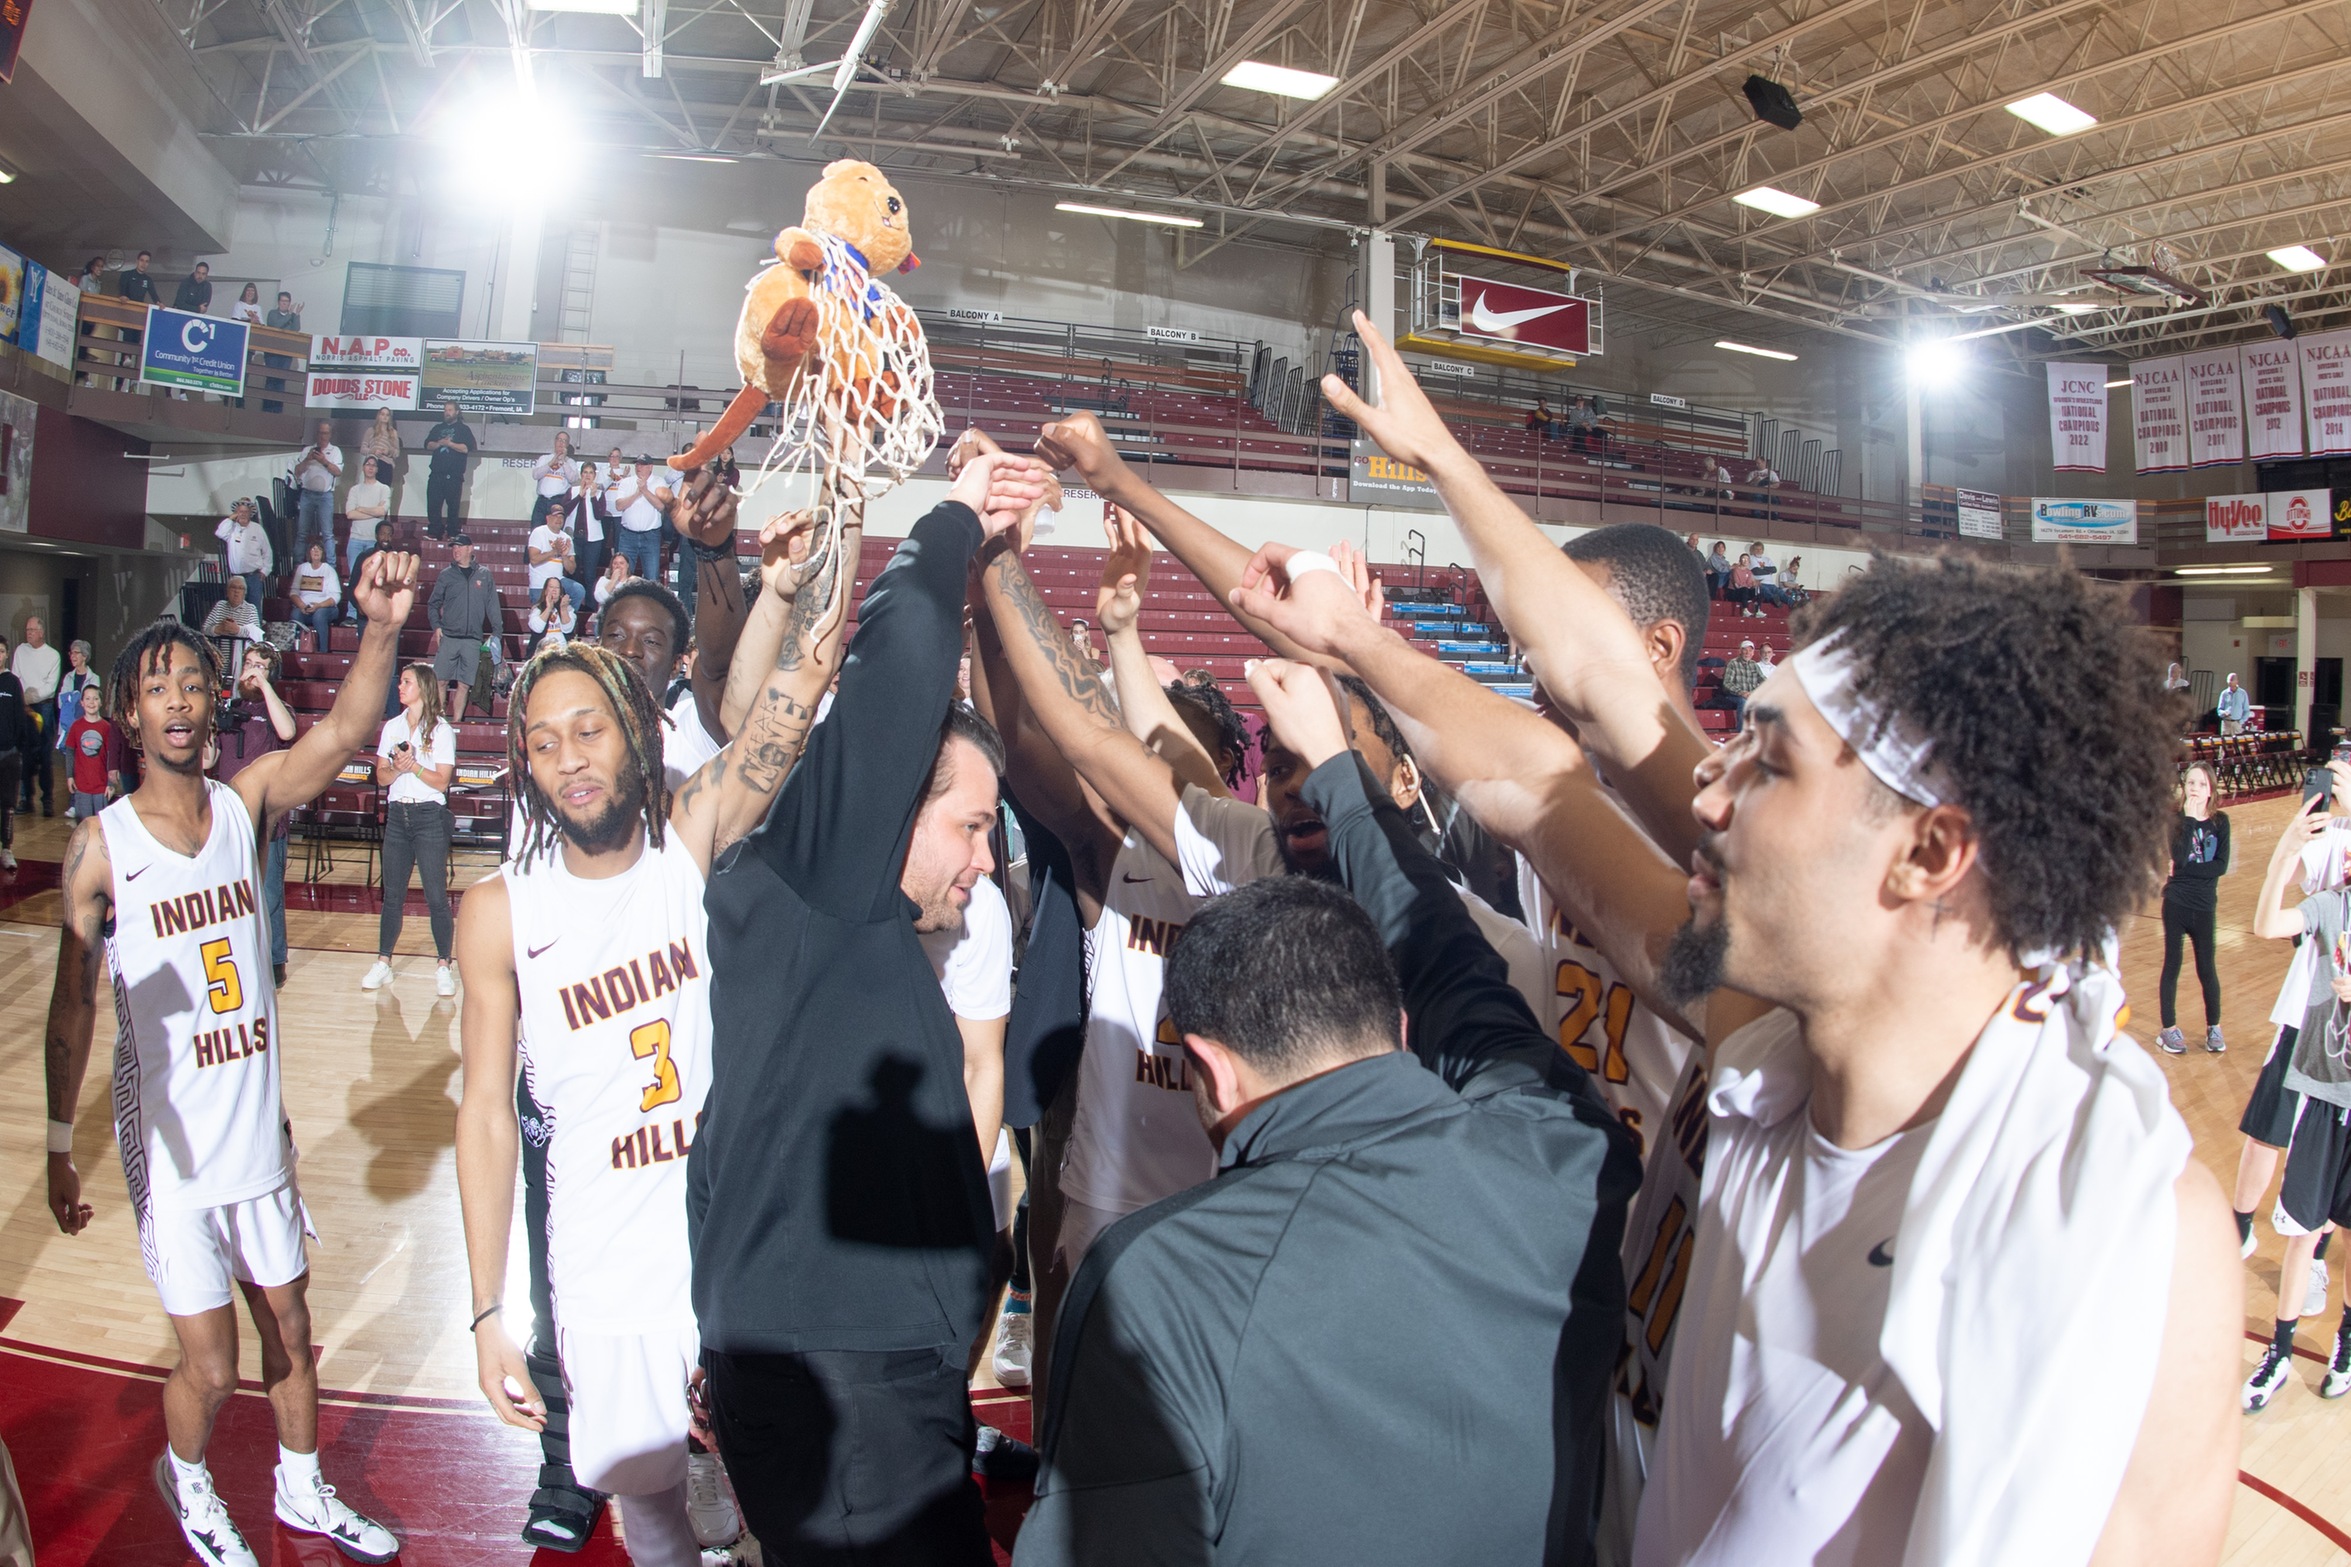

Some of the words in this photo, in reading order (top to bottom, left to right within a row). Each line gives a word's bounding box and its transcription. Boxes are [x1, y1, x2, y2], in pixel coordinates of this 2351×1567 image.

[950, 309, 989, 321] BALCONY
[993, 313, 1000, 321] A
[1150, 328, 1187, 340] BALCONY
[1190, 333, 1197, 341] B
[155, 350, 191, 365] Community
[199, 357, 218, 368] Credit
[218, 361, 235, 371] Union
[348, 355, 382, 363] ASPHALT
[386, 356, 415, 364] PAVING
[392, 348, 411, 357] co.
[2248, 350, 2290, 368] NJCAA
[2306, 344, 2351, 362] NJCAA
[193, 366, 213, 376] Together
[1433, 363, 1465, 374] BALCONY
[1467, 367, 1473, 375] C
[2190, 361, 2234, 379] NJCAA
[2135, 369, 2179, 386] NJCAA
[312, 378, 360, 397] DOUDS
[364, 379, 412, 399] STONE
[469, 389, 502, 397] Applications
[2256, 385, 2288, 400] NATIONAL
[2313, 385, 2351, 401] NATIONAL
[354, 393, 369, 401] LLC
[436, 394, 461, 402] Company
[1652, 394, 1678, 406] BALCONY
[2061, 405, 2097, 418] NATIONAL
[2140, 407, 2177, 423] NATIONAL
[2195, 400, 2233, 415] NATIONAL
[2255, 400, 2291, 416] CHAMPIONS
[2058, 420, 2100, 433] CHAMPIONS
[2137, 424, 2181, 440] CHAMPIONS
[2193, 416, 2238, 432] CHAMPIONS
[2325, 423, 2343, 435] 2014
[1063, 489, 1102, 499] RESER
[1353, 481, 1388, 489] Download
[1417, 486, 1437, 494] Today
[2040, 504, 2081, 520] Bowling
[151, 878, 256, 939] INDIAN
[199, 936, 244, 1015] 5
[558, 935, 700, 1032] INDIAN
[1556, 959, 1635, 1086] 21
[194, 1017, 268, 1069] HILLS
[629, 1017, 683, 1114] 3
[611, 1111, 703, 1170] HILL
